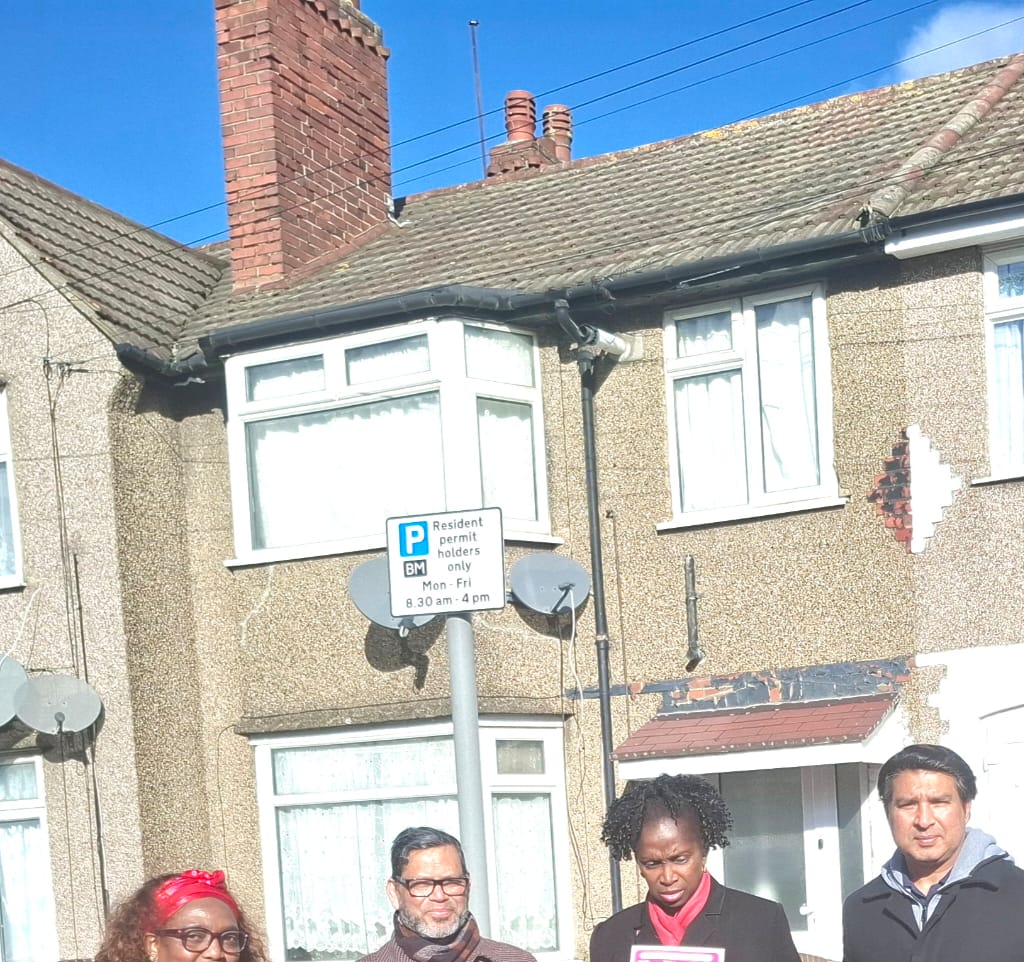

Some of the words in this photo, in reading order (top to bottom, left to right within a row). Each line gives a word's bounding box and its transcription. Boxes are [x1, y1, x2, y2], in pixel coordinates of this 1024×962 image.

[433, 517, 483, 531] Resident
[405, 524, 425, 555] P
[440, 532, 477, 546] permit
[438, 547, 480, 559] holders
[405, 562, 426, 576] BM
[448, 561, 472, 573] only
[423, 581, 447, 591] Mon
[456, 578, 472, 589] Fri
[406, 596, 432, 608] 8.30
[436, 597, 452, 606] am
[462, 593, 469, 603] 4
[473, 594, 490, 604] pm
